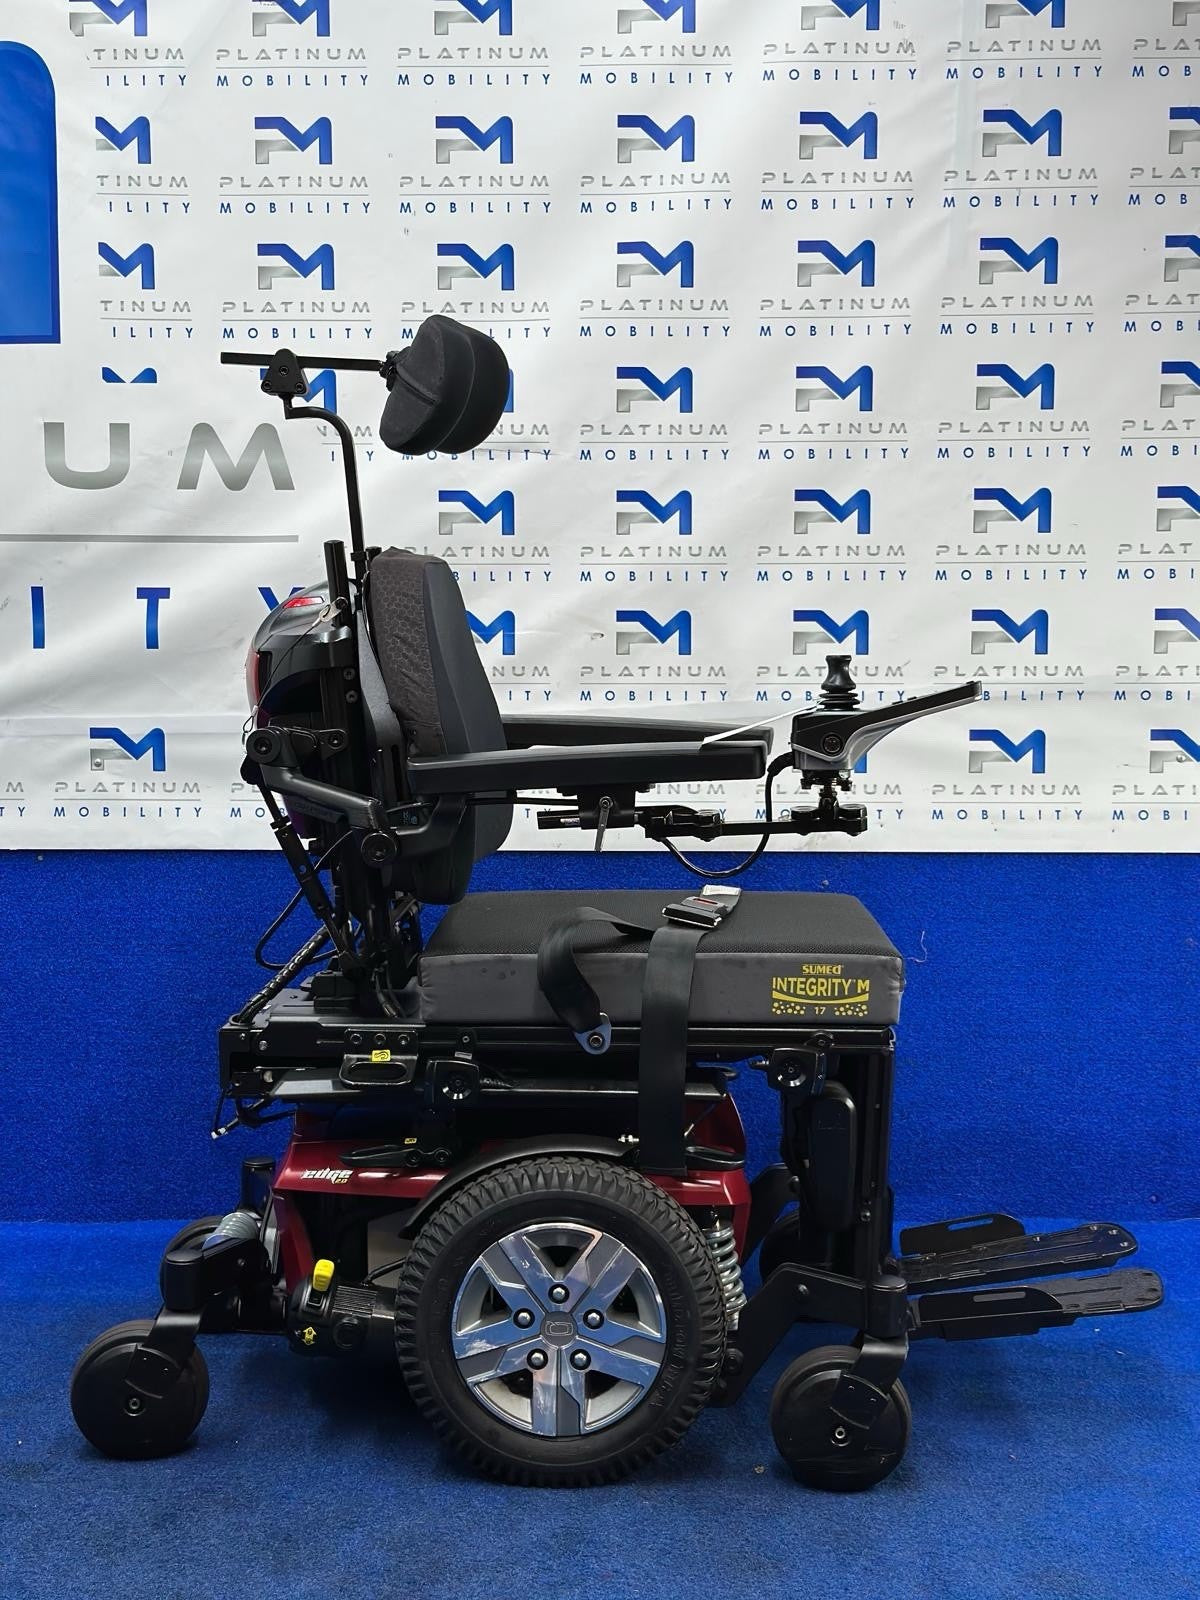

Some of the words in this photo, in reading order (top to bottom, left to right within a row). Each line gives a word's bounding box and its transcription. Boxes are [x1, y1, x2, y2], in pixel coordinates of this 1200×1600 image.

[580, 44, 731, 58] PLATINUM
[764, 42, 915, 56] PLATINUM
[947, 40, 1102, 53] PLATINUM
[216, 48, 366, 60] PLATINUM
[398, 47, 548, 59] PLATINUM
[763, 68, 917, 81] MOBILITY
[946, 65, 1102, 78] MOBILITY
[217, 75, 368, 87] MOBILITY
[398, 73, 550, 85] MOBILITY
[580, 72, 733, 85] MOBILITY
[581, 172, 730, 187] PLATINUM
[761, 171, 912, 184] PLATINUM
[944, 168, 1097, 182] PLATINUM
[220, 176, 368, 189] PLATINUM
[400, 176, 549, 187] PLATINUM
[580, 200, 733, 213] MOBILITY
[761, 197, 914, 210] MOBILITY
[943, 194, 1098, 208] MOBILITY
[220, 202, 370, 214] MOBILITY
[400, 201, 551, 214] MOBILITY
[222, 300, 370, 313] PLATINUM
[402, 301, 549, 313] PLATINUM
[580, 299, 728, 311] PLATINUM
[760, 298, 910, 310] PLATINUM
[941, 295, 1093, 308] PLATINUM
[223, 328, 372, 340] MOBILITY
[580, 325, 730, 337] MOBILITY
[760, 324, 912, 336] MOBILITY
[940, 322, 1094, 335] MOBILITY
[580, 424, 727, 435] PLATINUM
[759, 423, 907, 435] PLATINUM
[938, 421, 1089, 433] PLATINUM
[580, 448, 730, 461] MOBILITY
[758, 447, 909, 460] MOBILITY
[937, 446, 1091, 459] MOBILITY
[580, 546, 727, 557] PLATINUM
[757, 545, 905, 557] PLATINUM
[936, 544, 1086, 556] PLATINUM
[580, 570, 728, 582] MOBILITY
[757, 570, 907, 581] MOBILITY
[935, 569, 1087, 581] MOBILITY
[580, 666, 726, 677] PLATINUM
[934, 665, 1084, 677] PLATINUM
[580, 690, 728, 702] MOBILITY
[55, 782, 201, 793] PLATINUM
[932, 784, 1081, 796] PLATINUM
[54, 806, 202, 818] MOBILITY
[932, 809, 1083, 821] MOBILITY
[814, 1006, 826, 1015] 17
